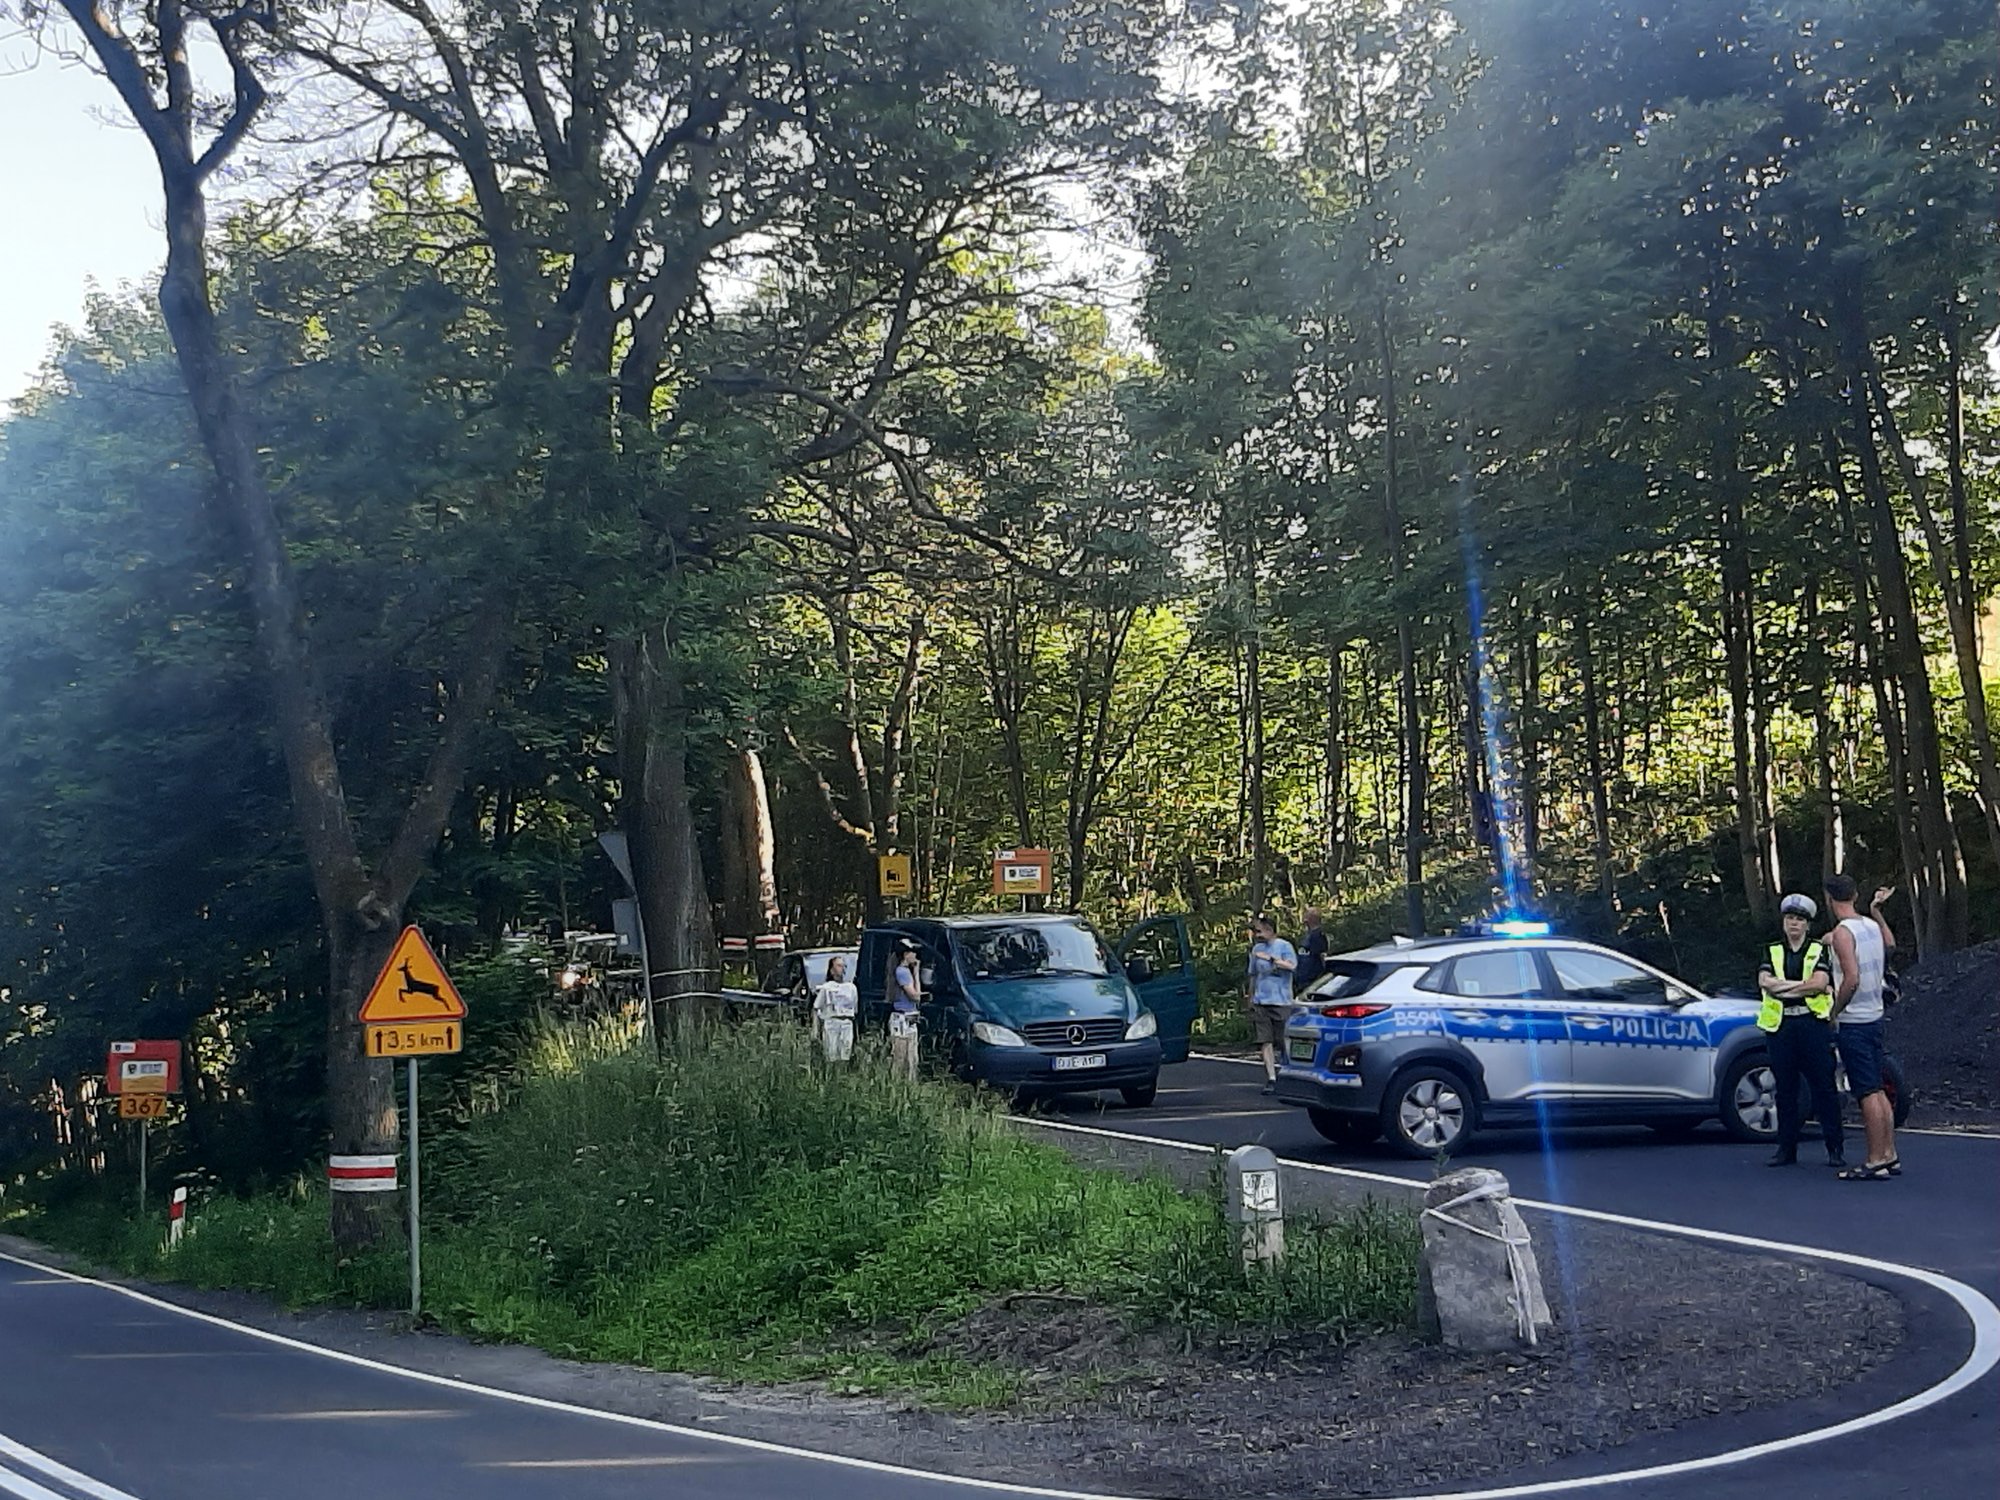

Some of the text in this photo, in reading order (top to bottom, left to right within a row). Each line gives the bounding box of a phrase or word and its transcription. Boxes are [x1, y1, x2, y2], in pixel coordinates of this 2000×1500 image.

[1612, 1017, 1701, 1040] POLICJA
[420, 1033, 444, 1047] km
[125, 1098, 163, 1115] 367
